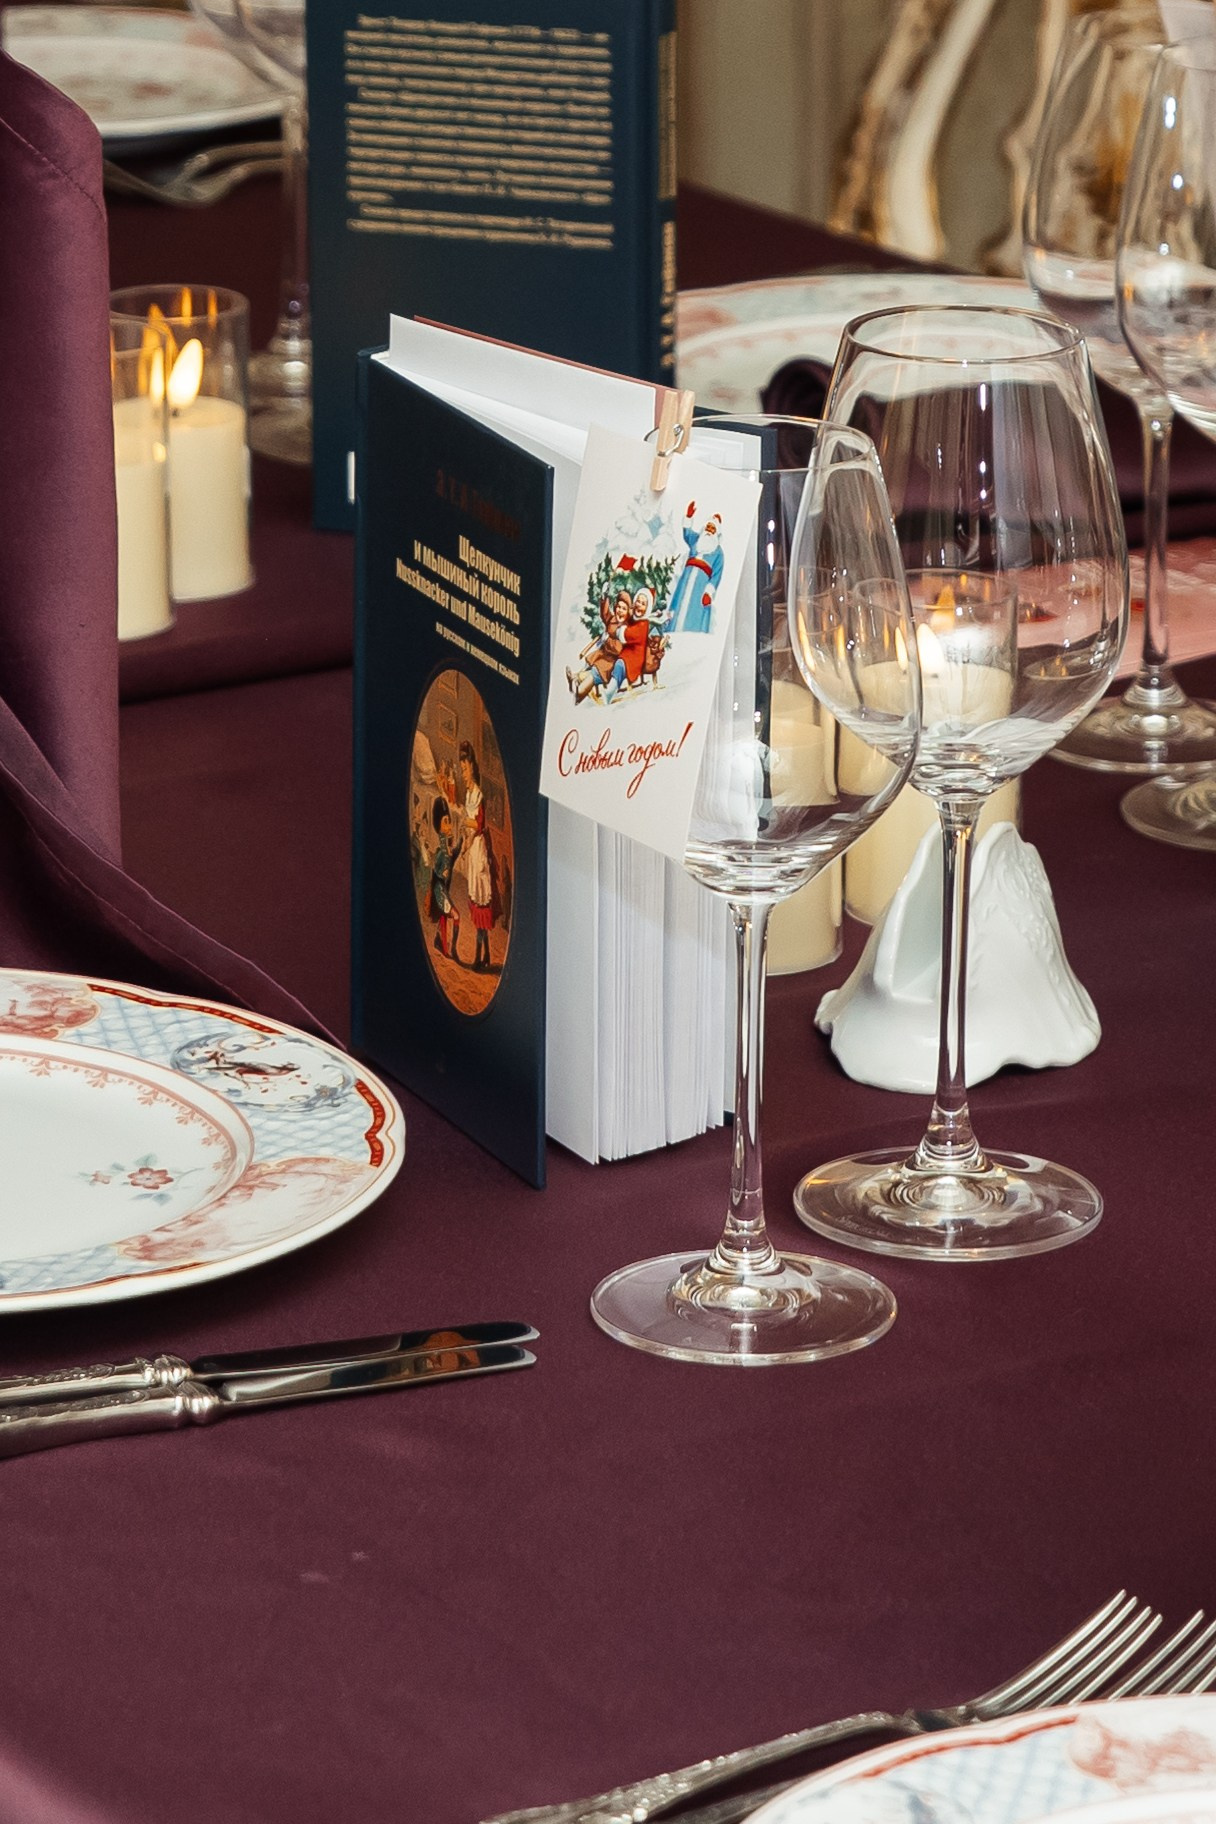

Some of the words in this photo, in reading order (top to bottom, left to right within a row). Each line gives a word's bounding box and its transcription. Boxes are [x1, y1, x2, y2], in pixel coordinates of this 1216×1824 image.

[396, 557, 450, 610] Nussknacker
[423, 545, 480, 600] мышиный
[481, 581, 521, 626] король
[459, 534, 521, 596] Щелкунчик
[626, 721, 695, 799] годом!
